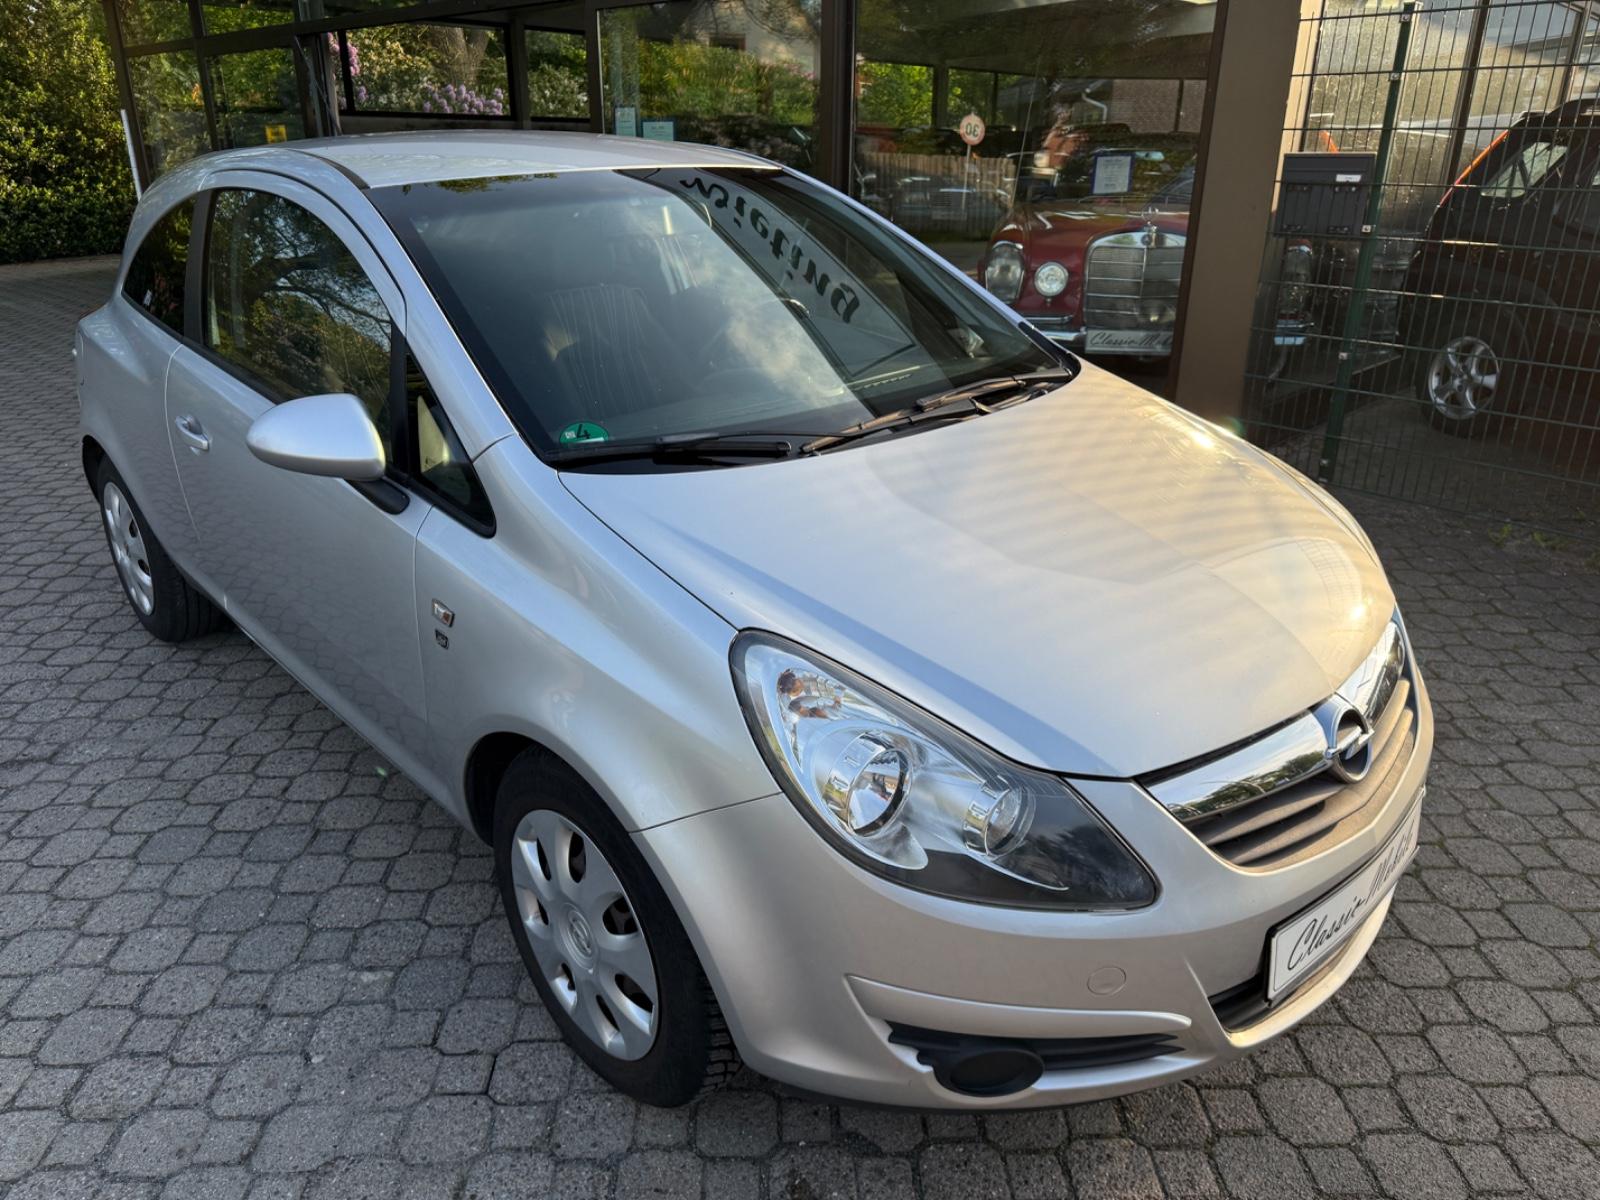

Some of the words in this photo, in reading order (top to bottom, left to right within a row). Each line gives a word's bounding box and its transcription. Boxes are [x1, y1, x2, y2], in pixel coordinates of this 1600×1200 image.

[1090, 331, 1138, 346] Classic
[576, 423, 591, 439] 4
[1287, 896, 1366, 971] Classic
